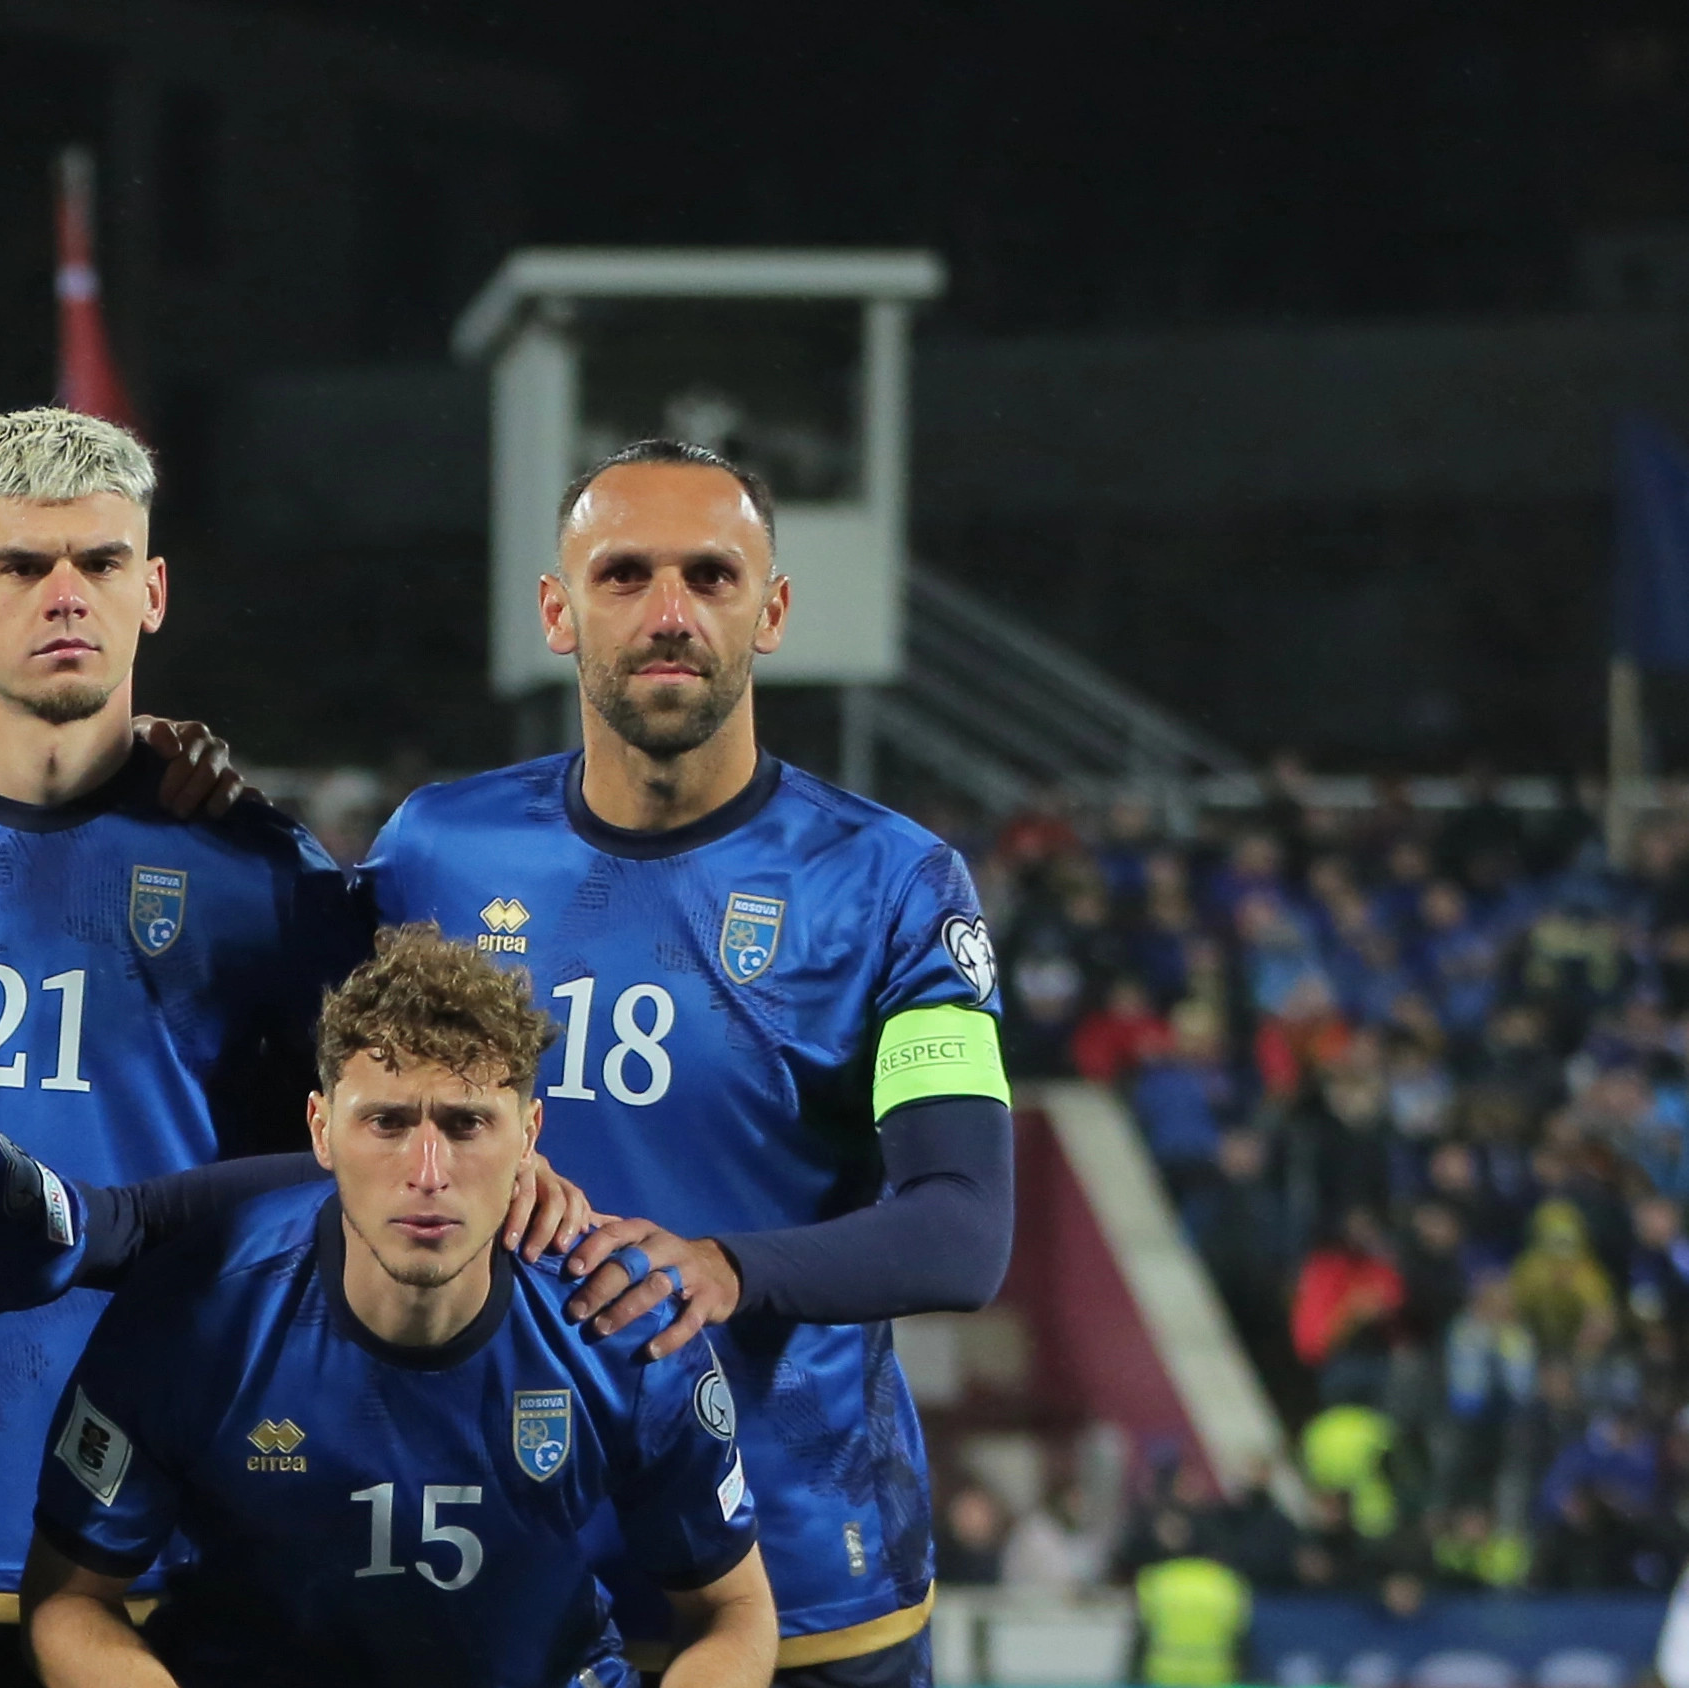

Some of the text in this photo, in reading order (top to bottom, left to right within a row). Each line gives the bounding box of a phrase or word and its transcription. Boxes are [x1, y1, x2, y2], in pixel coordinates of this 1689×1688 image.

[137, 871, 181, 889] KOSOVA
[732, 900, 778, 917] KOSOVA
[476, 932, 528, 954] errea
[547, 977, 675, 1106] 18
[879, 1040, 967, 1075] RESPECT
[518, 1396, 566, 1410] KOSOVA
[246, 1455, 308, 1473] errea
[350, 1482, 484, 1591] 15
